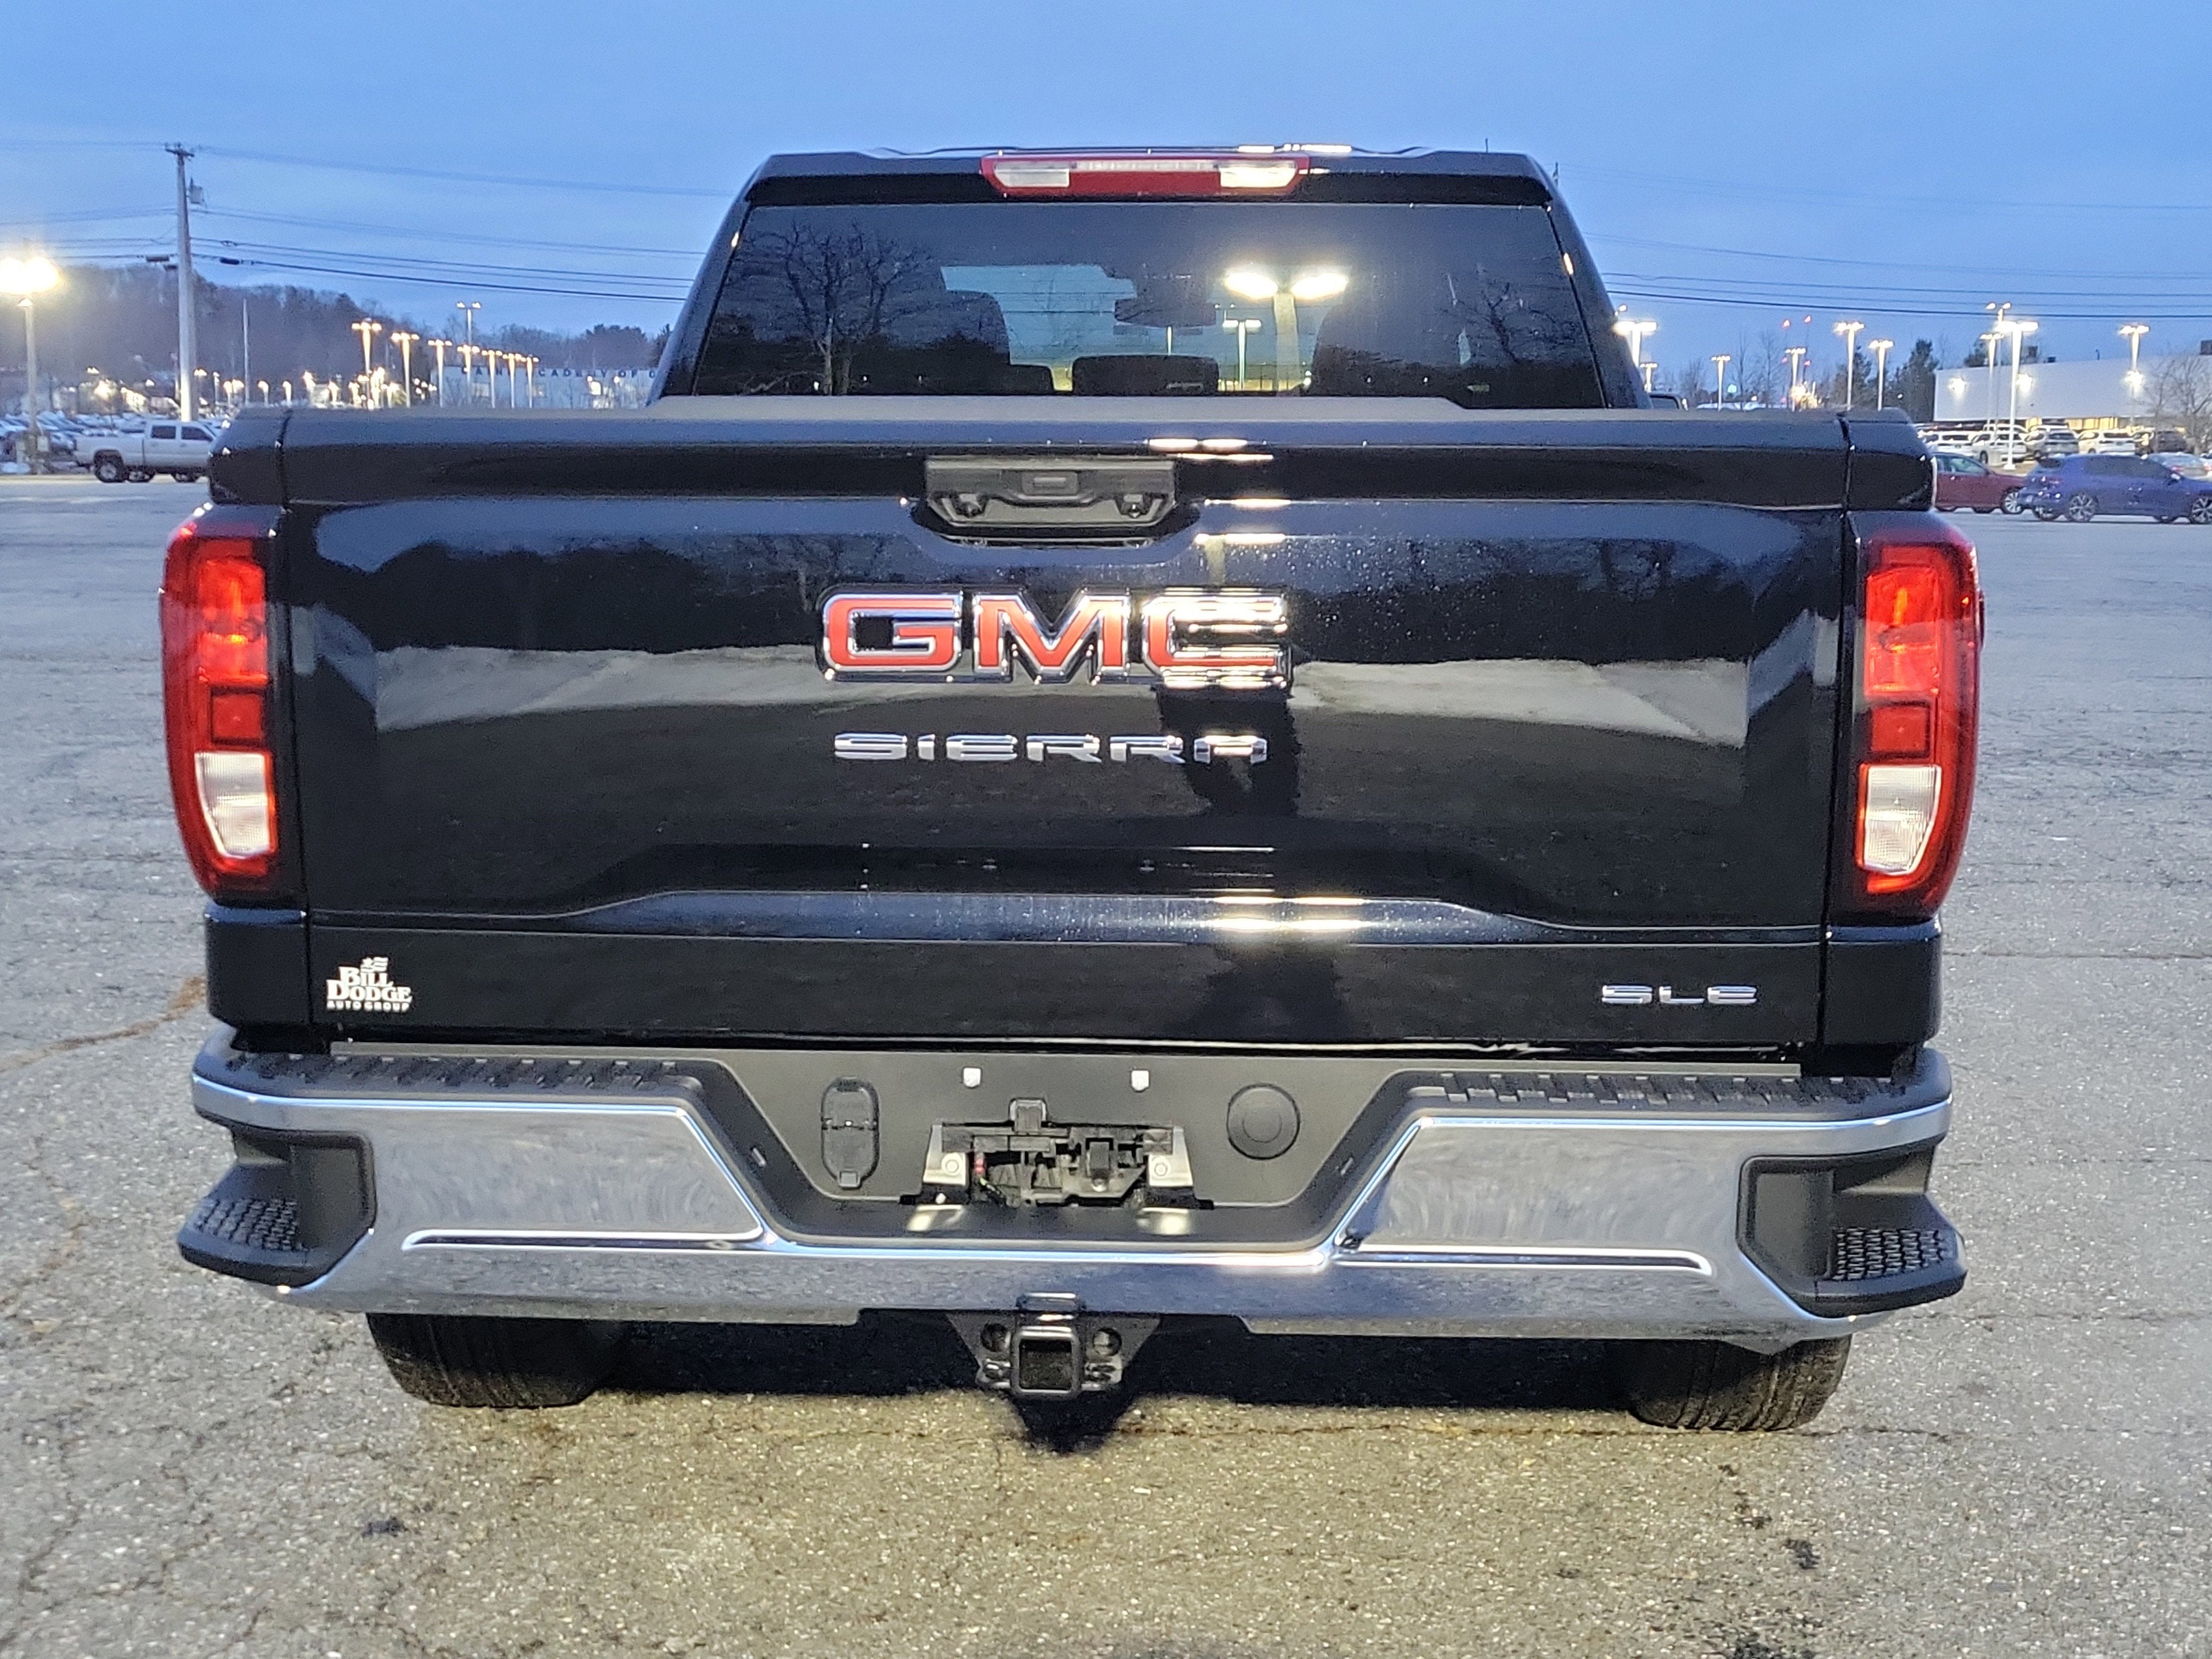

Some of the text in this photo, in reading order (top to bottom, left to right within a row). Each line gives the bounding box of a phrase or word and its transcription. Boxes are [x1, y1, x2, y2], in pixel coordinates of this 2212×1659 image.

[822, 591, 1291, 689] GMC
[834, 733, 1269, 765] SIERRA
[326, 1000, 410, 1012] AUTO GROUP
[1602, 985, 1757, 1003] SLE
